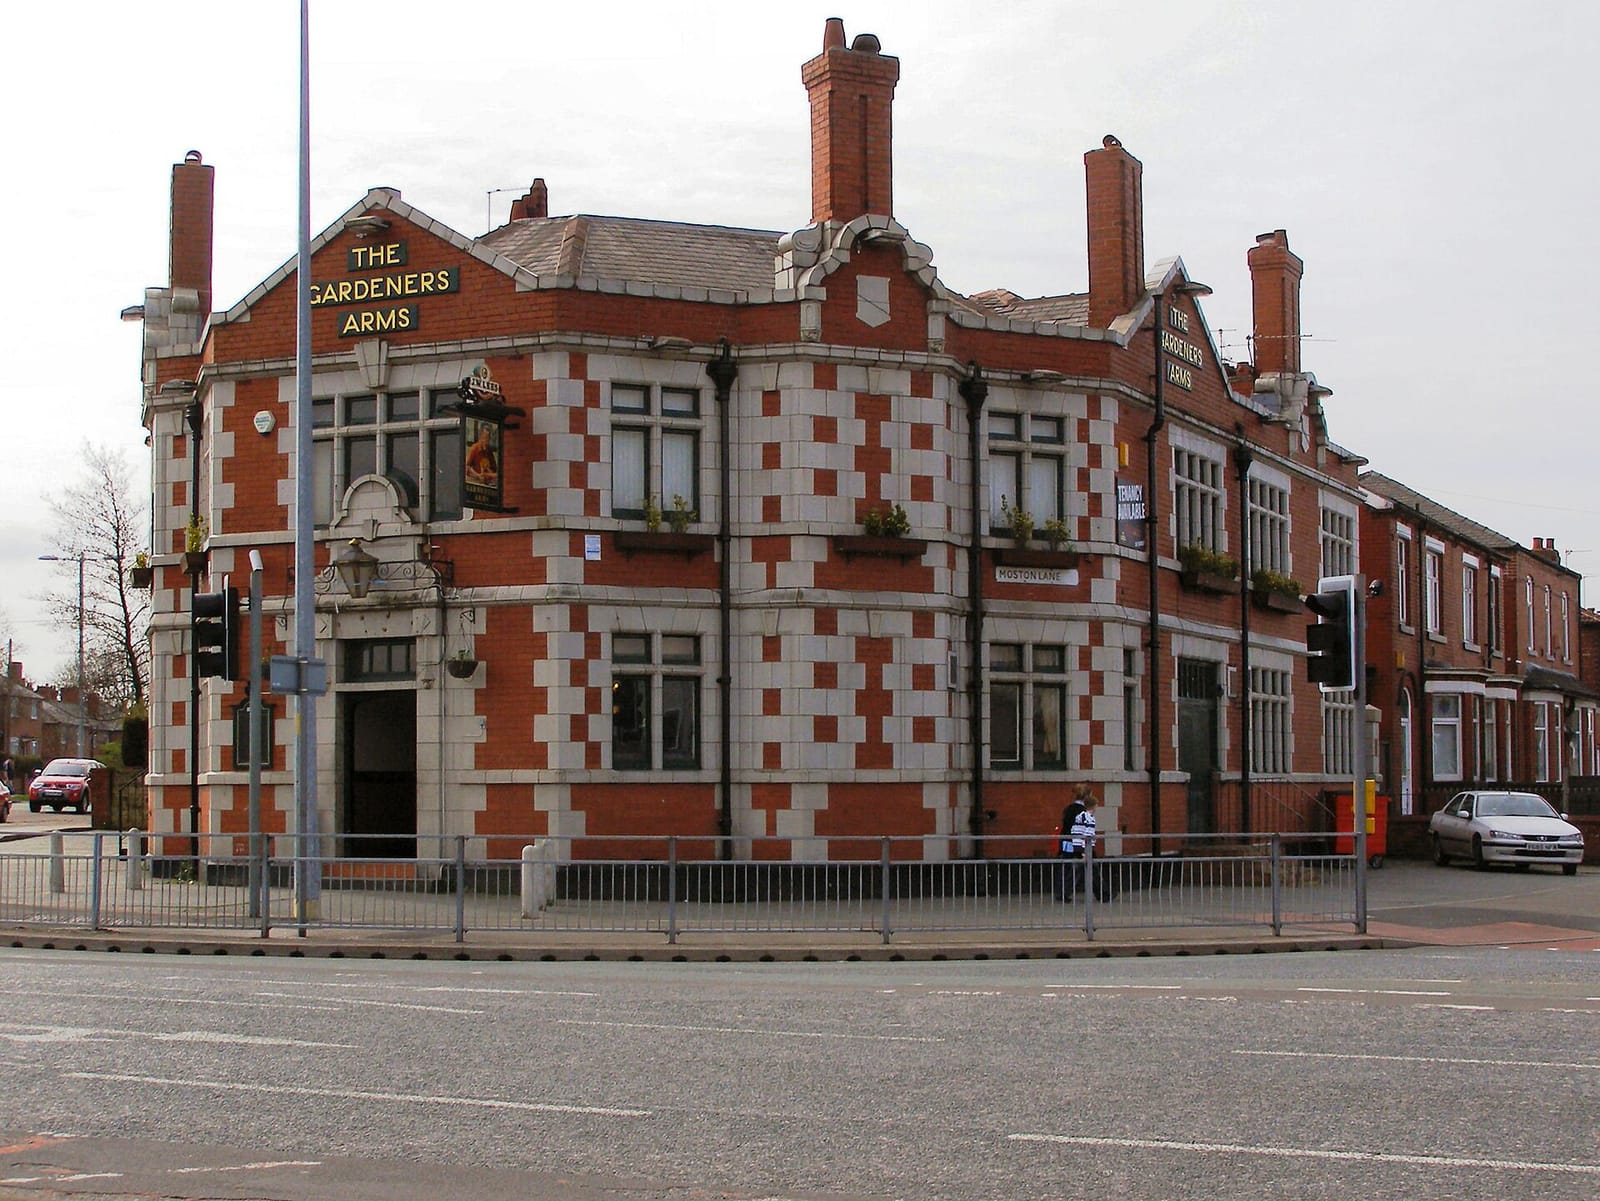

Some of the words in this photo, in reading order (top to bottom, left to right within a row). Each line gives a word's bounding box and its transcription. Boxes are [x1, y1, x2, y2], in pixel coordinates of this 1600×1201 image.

[352, 243, 400, 268] THE
[310, 270, 450, 305] GARDENERS
[342, 307, 411, 334] ARMS
[1172, 306, 1189, 332] THE
[1170, 363, 1192, 388] ARMS
[1117, 484, 1143, 502] TENANCY
[999, 569, 1036, 580] MOSTON
[1039, 571, 1061, 581] LANE
